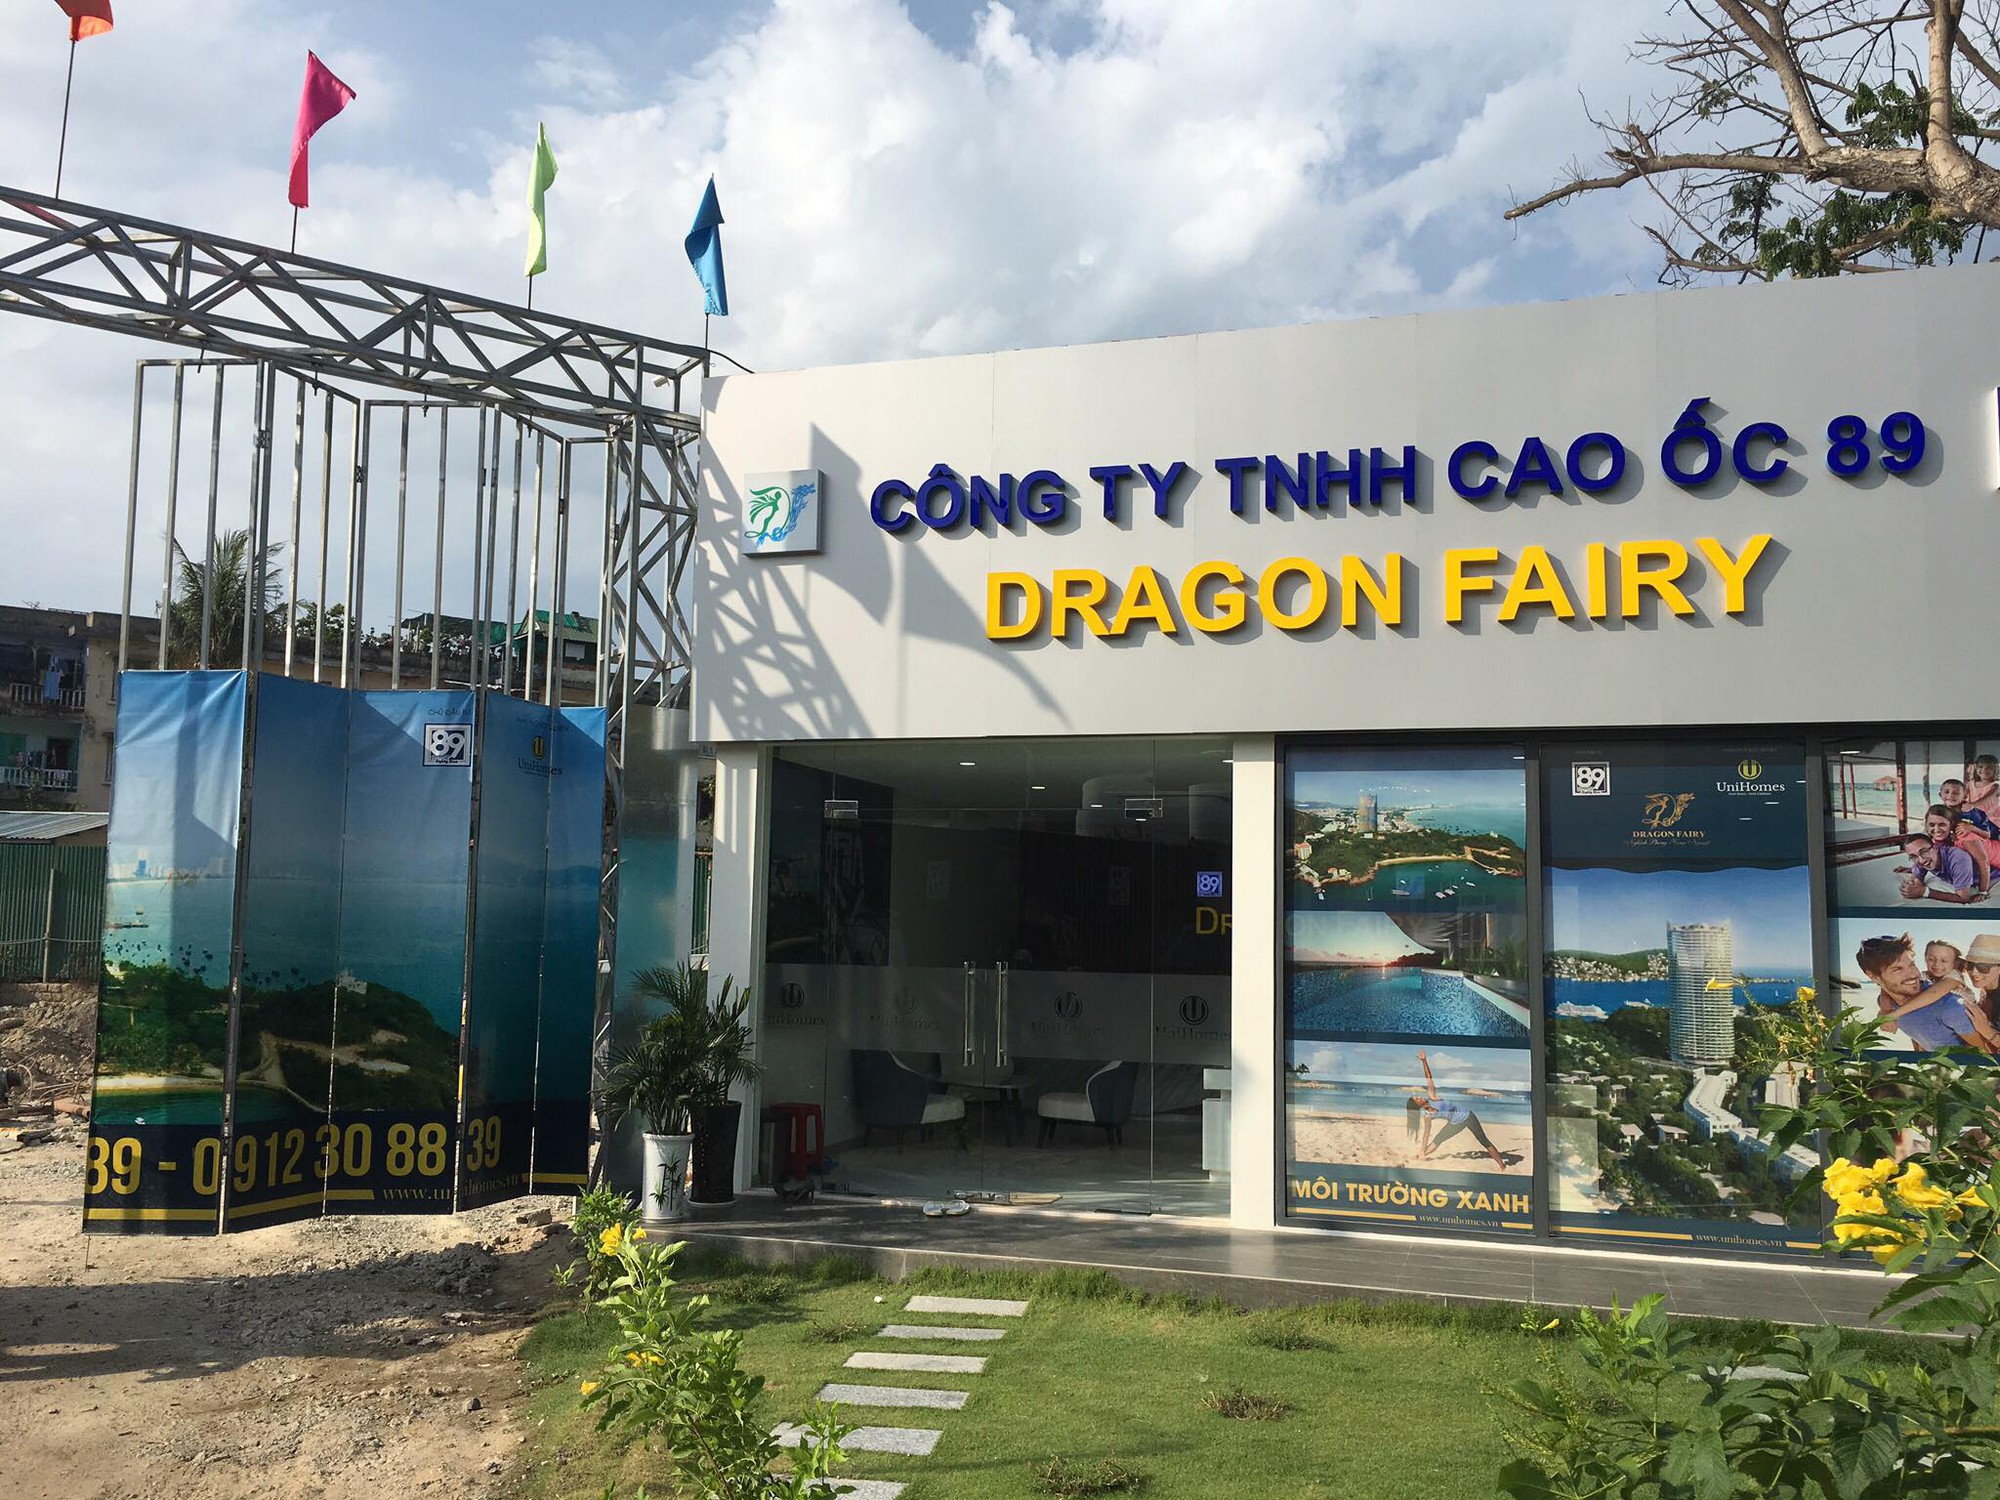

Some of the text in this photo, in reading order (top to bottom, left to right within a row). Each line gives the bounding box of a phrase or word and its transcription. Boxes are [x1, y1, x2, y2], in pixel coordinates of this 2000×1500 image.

[870, 396, 1926, 533] CÔNG TY TNHH CAO ỐC 89
[986, 533, 1773, 640] DRAGON FAIRY
[430, 729, 466, 758] 89
[1577, 766, 1605, 790] 89
[1716, 781, 1786, 792] UniHomes
[1632, 830, 1706, 838] DRAGON FAIRY
[1199, 874, 1219, 893] 89
[85, 1136, 142, 1195] 89
[313, 1122, 372, 1179] 30
[385, 1122, 448, 1177] 88
[466, 1115, 502, 1172] 39
[1294, 1175, 1530, 1214] MÔI TRƯỜNG XANH
[1418, 1214, 1499, 1228] www.unihomes.vn
[1695, 1233, 1782, 1247] www.unihomes.vn
